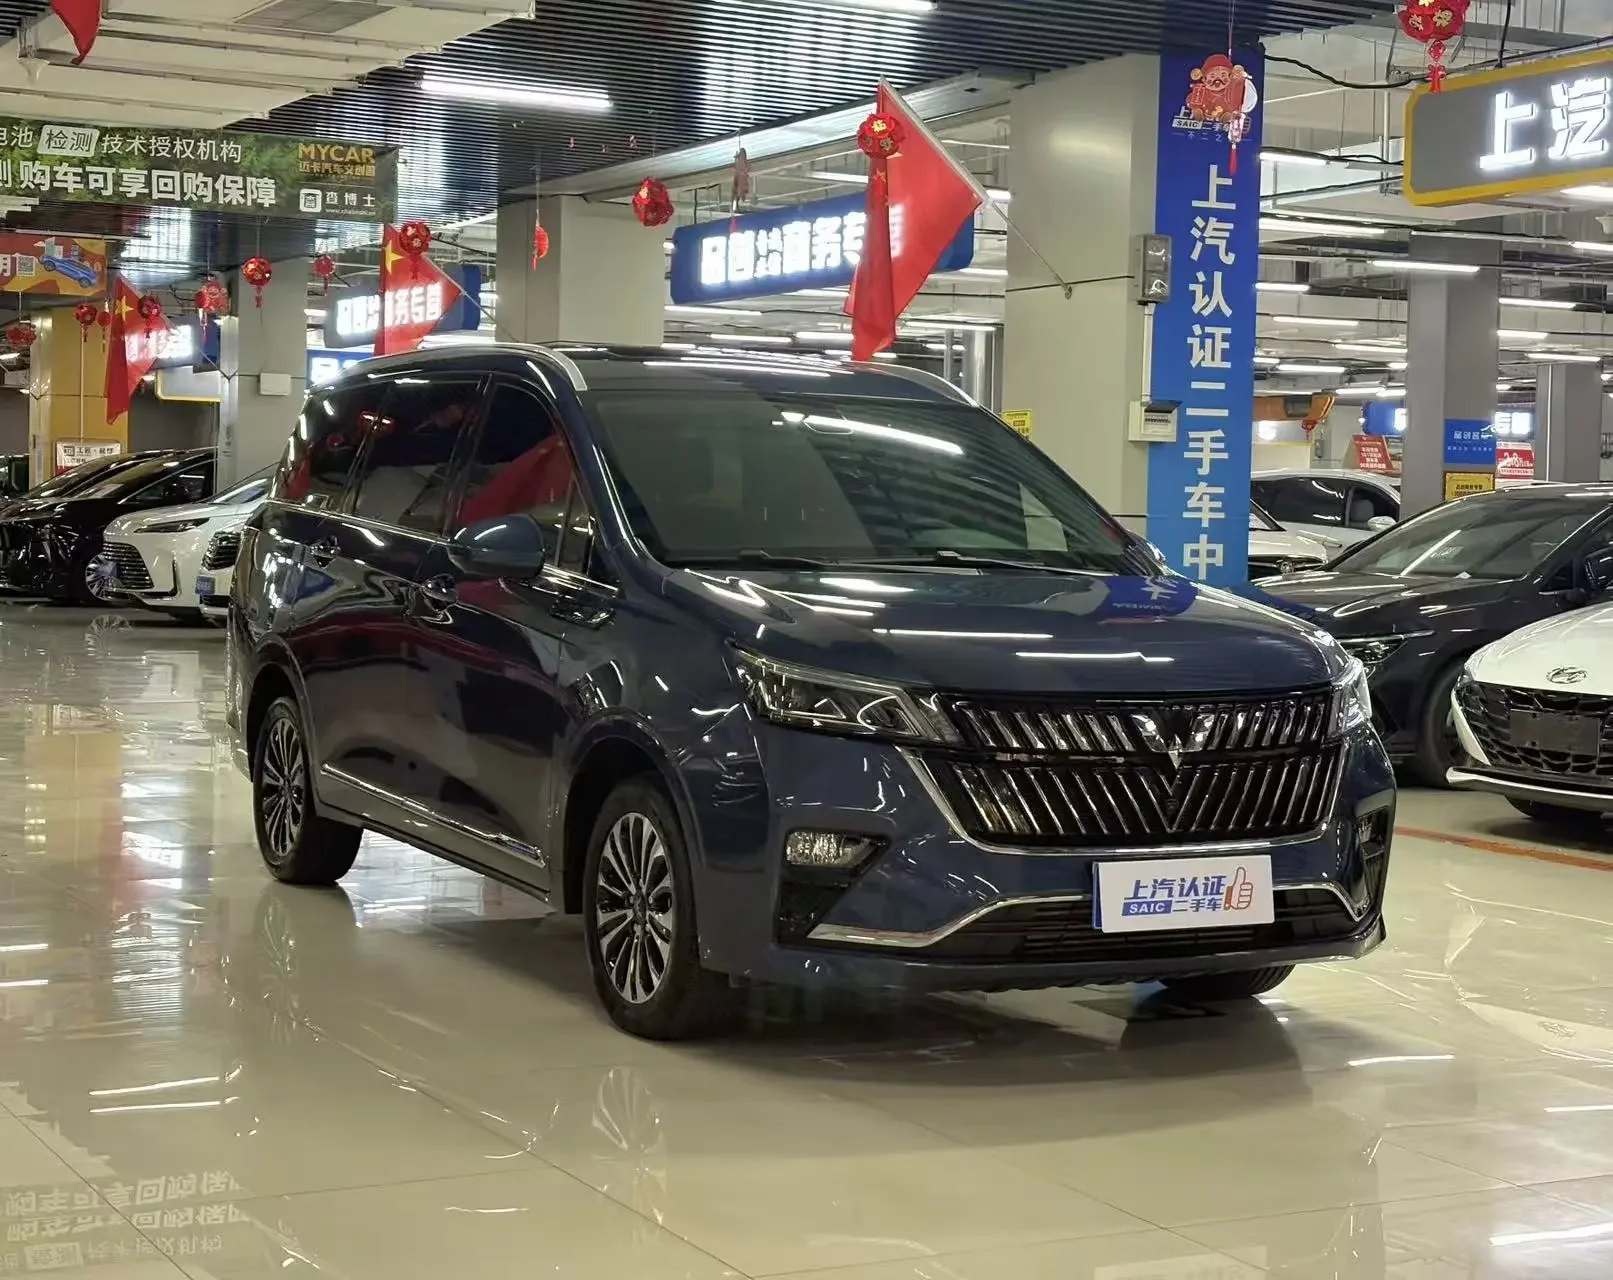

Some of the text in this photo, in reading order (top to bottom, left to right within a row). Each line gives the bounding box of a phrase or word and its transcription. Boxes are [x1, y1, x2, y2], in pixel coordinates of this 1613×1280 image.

[1176, 120, 1199, 128] SAIC
[1480, 77, 1609, 170] 上汽
[46, 129, 93, 152] 检测
[101, 133, 241, 163] 技术授权机构
[298, 142, 376, 164] MYCAR
[325, 191, 376, 207] 查博士
[1124, 875, 1227, 900] 上汽认证
[1128, 903, 1167, 914] SAIC
[1172, 897, 1224, 912] 二手车
